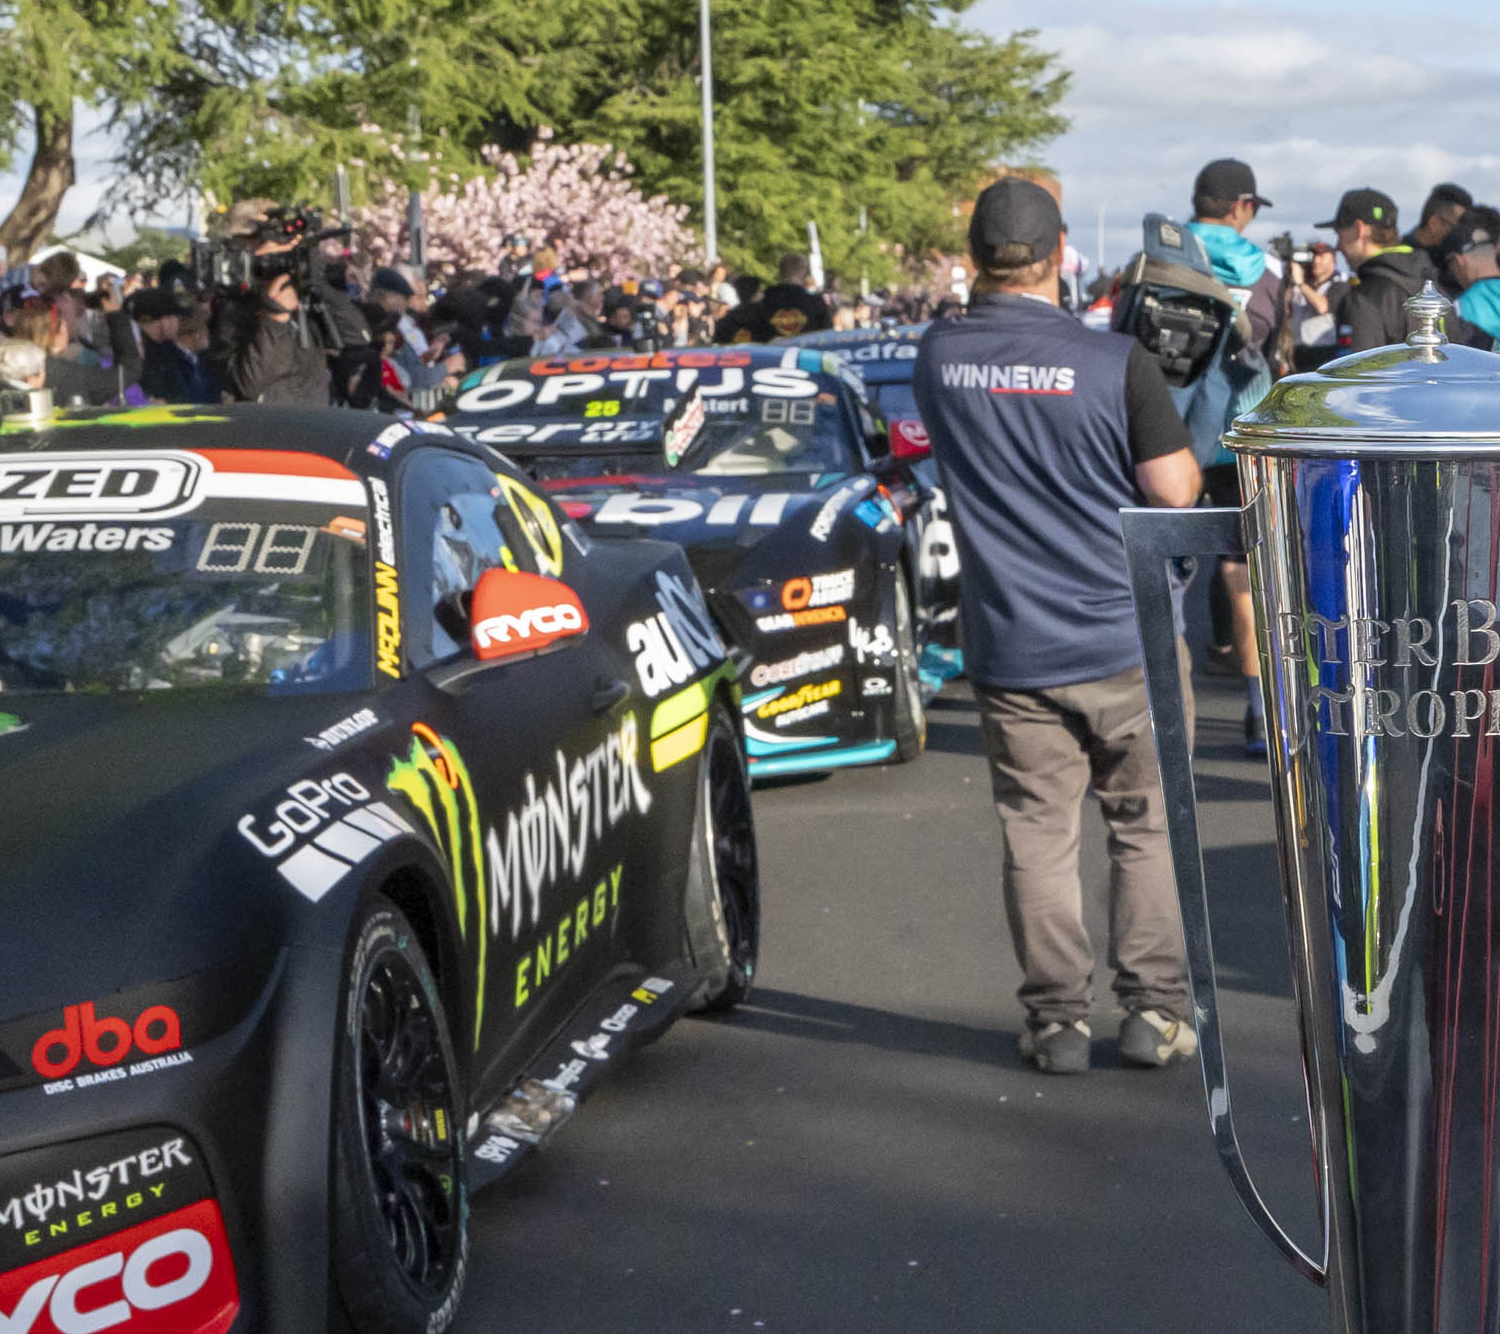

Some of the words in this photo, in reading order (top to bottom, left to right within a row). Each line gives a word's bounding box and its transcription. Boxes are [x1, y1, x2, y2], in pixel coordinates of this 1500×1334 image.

[456, 368, 819, 412] OPTUS
[585, 400, 620, 418] 25
[0, 522, 176, 553] Waters
[474, 603, 583, 648] RYCO
[1277, 612, 1438, 667] ETER
[318, 707, 379, 749] DUNLOP
[237, 772, 372, 857] GoPro
[486, 709, 652, 937] MONSTER
[515, 864, 623, 1009] ENERGY
[31, 1001, 182, 1078] dba
[43, 1079, 75, 1096] DISC
[76, 1068, 127, 1088] BRAKES
[129, 1050, 194, 1077] AUSTRALIA
[24, 1182, 165, 1246] ENERGY
